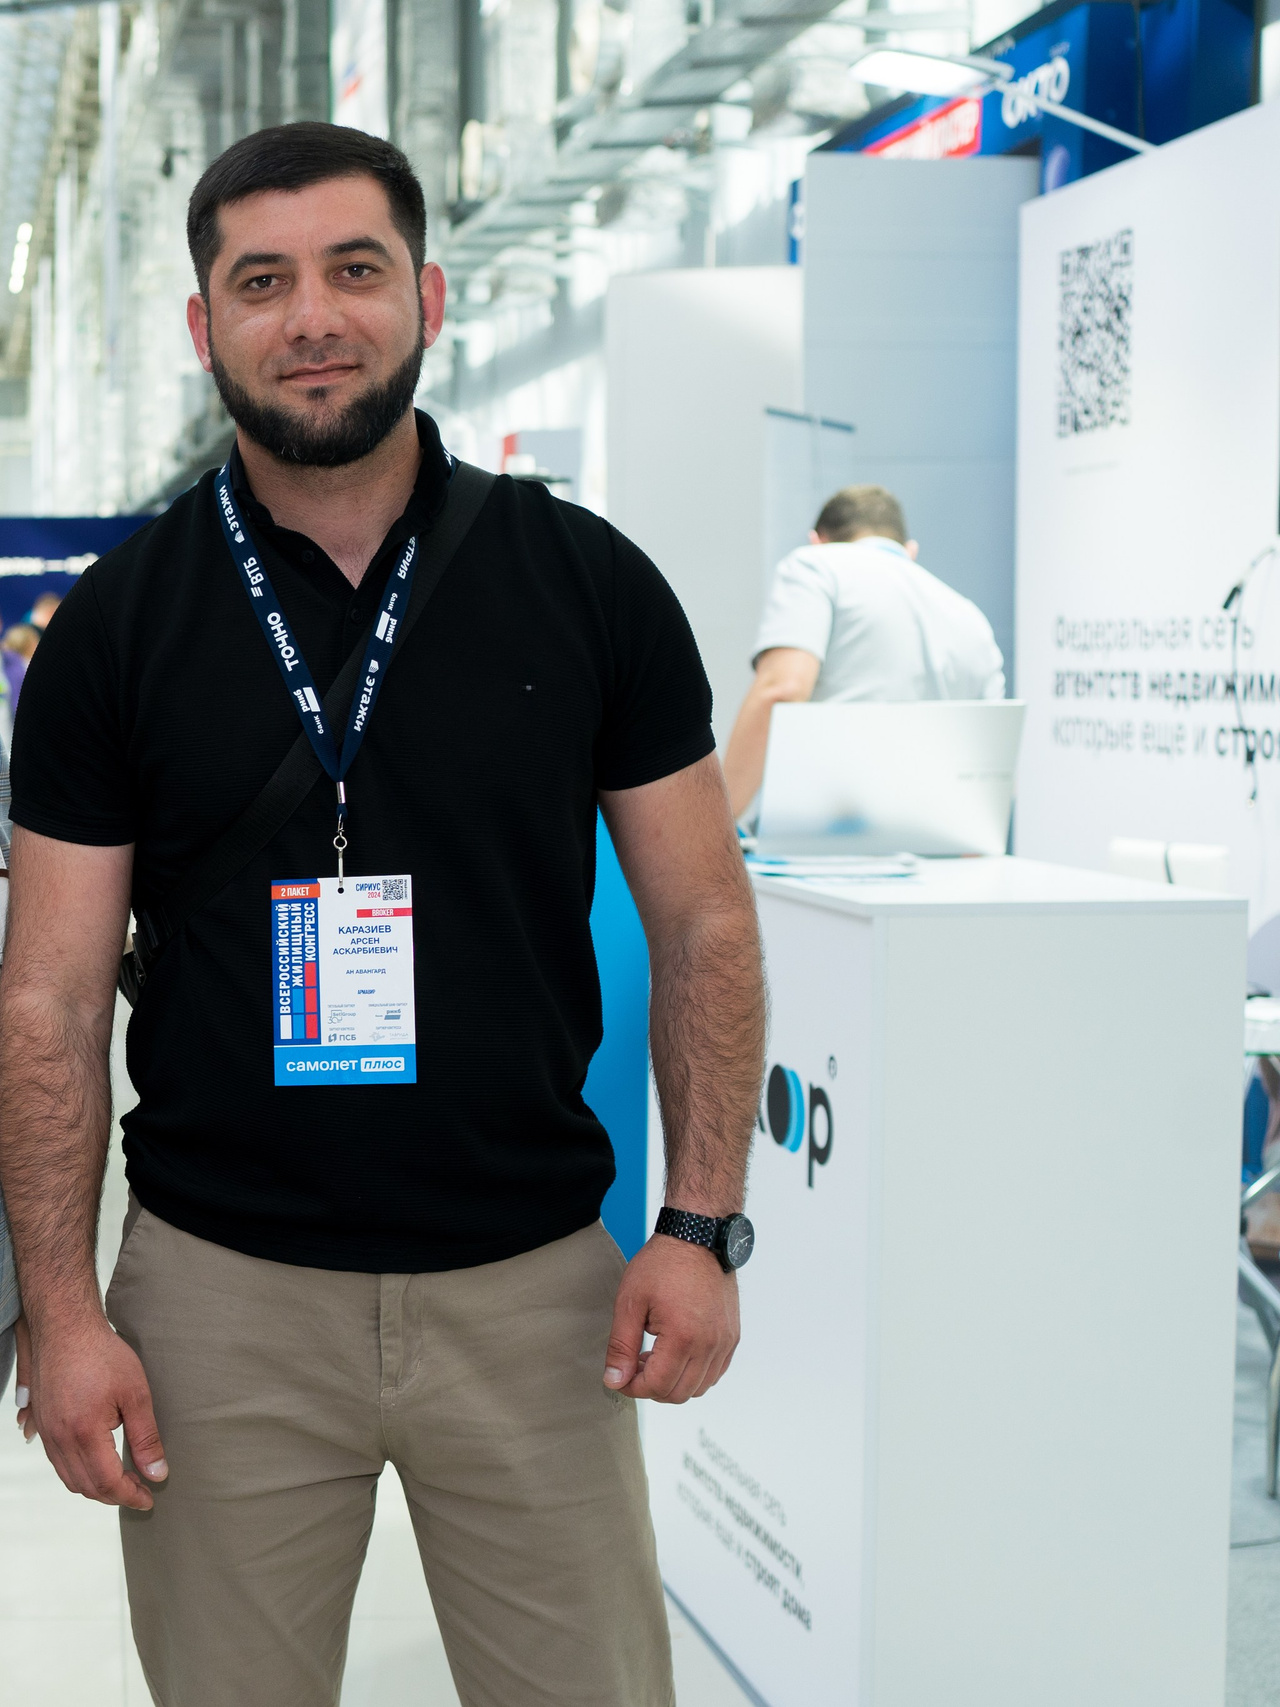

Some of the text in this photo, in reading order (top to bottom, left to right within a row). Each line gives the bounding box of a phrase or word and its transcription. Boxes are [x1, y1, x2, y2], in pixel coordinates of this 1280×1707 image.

[219, 485, 240, 532] этажи
[243, 556, 265, 586] ВТБ
[387, 592, 398, 611] банк
[267, 612, 299, 672] ТОЧНО
[1200, 616, 1255, 650] сеть
[354, 675, 376, 732] этажи
[1054, 668, 1280, 710] агентств недвижим
[313, 714, 324, 735] банк
[1053, 716, 1280, 768] которые еще и стро
[281, 886, 310, 897] 2 ПАКЕТ
[356, 882, 381, 892] СИРИУС
[367, 891, 381, 899] 2024
[288, 903, 304, 987] ЖИЛИЩНЫЙ
[304, 902, 316, 961] КОНГРЕСС
[338, 925, 392, 935] КАРАЗИЕВ
[350, 937, 380, 945] АРСЕН
[275, 903, 291, 1014] ВСЕРОССИЙСКИЙ
[333, 946, 398, 955] АСКАРБИЕВИЧ
[286, 1060, 402, 1072] самолет плюс
